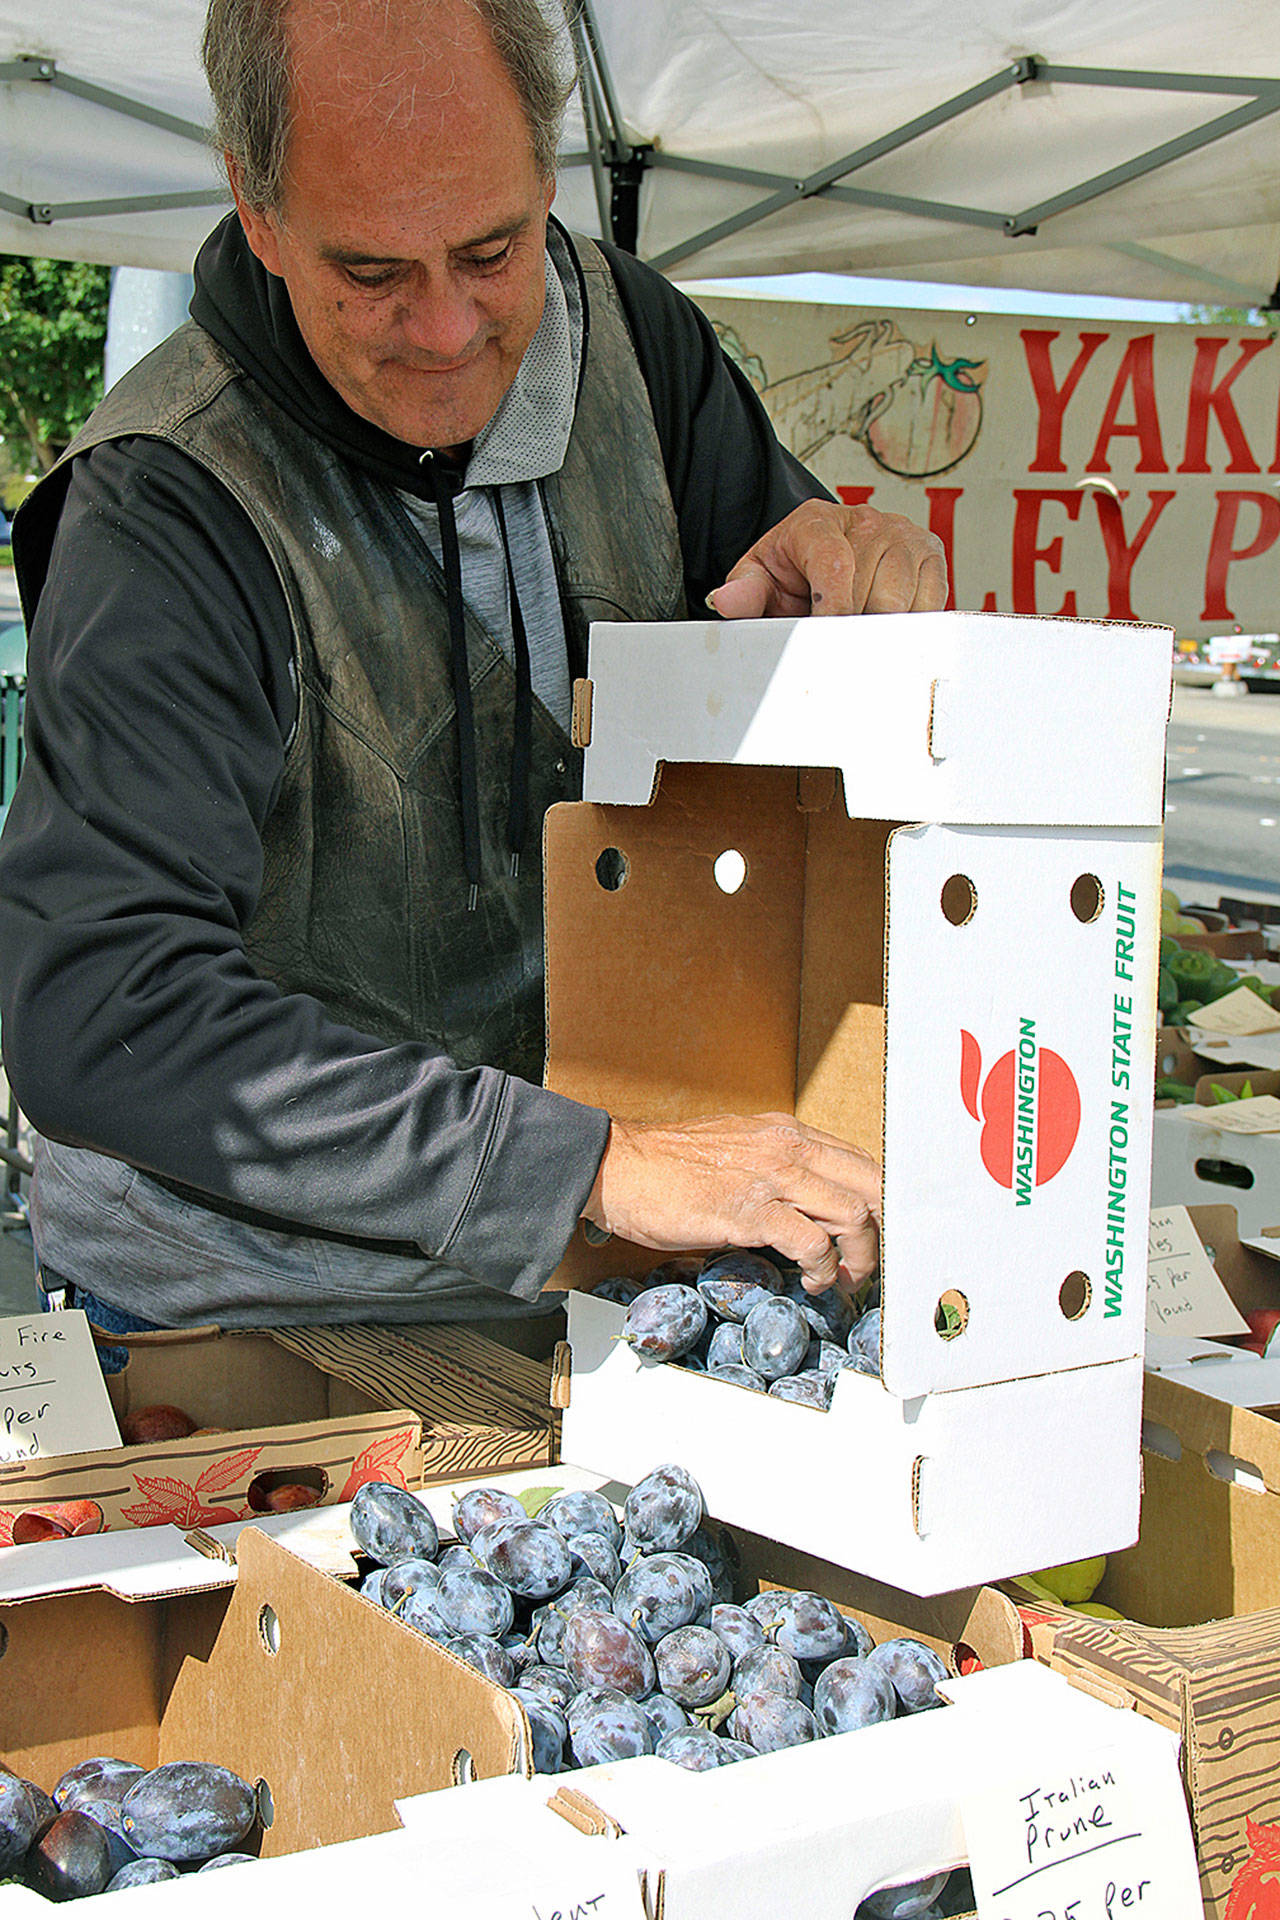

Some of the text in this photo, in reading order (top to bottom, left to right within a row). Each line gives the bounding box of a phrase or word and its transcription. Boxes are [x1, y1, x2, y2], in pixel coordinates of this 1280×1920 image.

[1020, 329, 1280, 474] YAK
[836, 486, 1176, 622] LEY
[1015, 1017, 1036, 1207] WASHINGTON
[1103, 882, 1137, 1319] WASHINGTON STATE FRUIT
[16, 1324, 67, 1347] Fire
[1019, 1770, 1116, 1823] Italian
